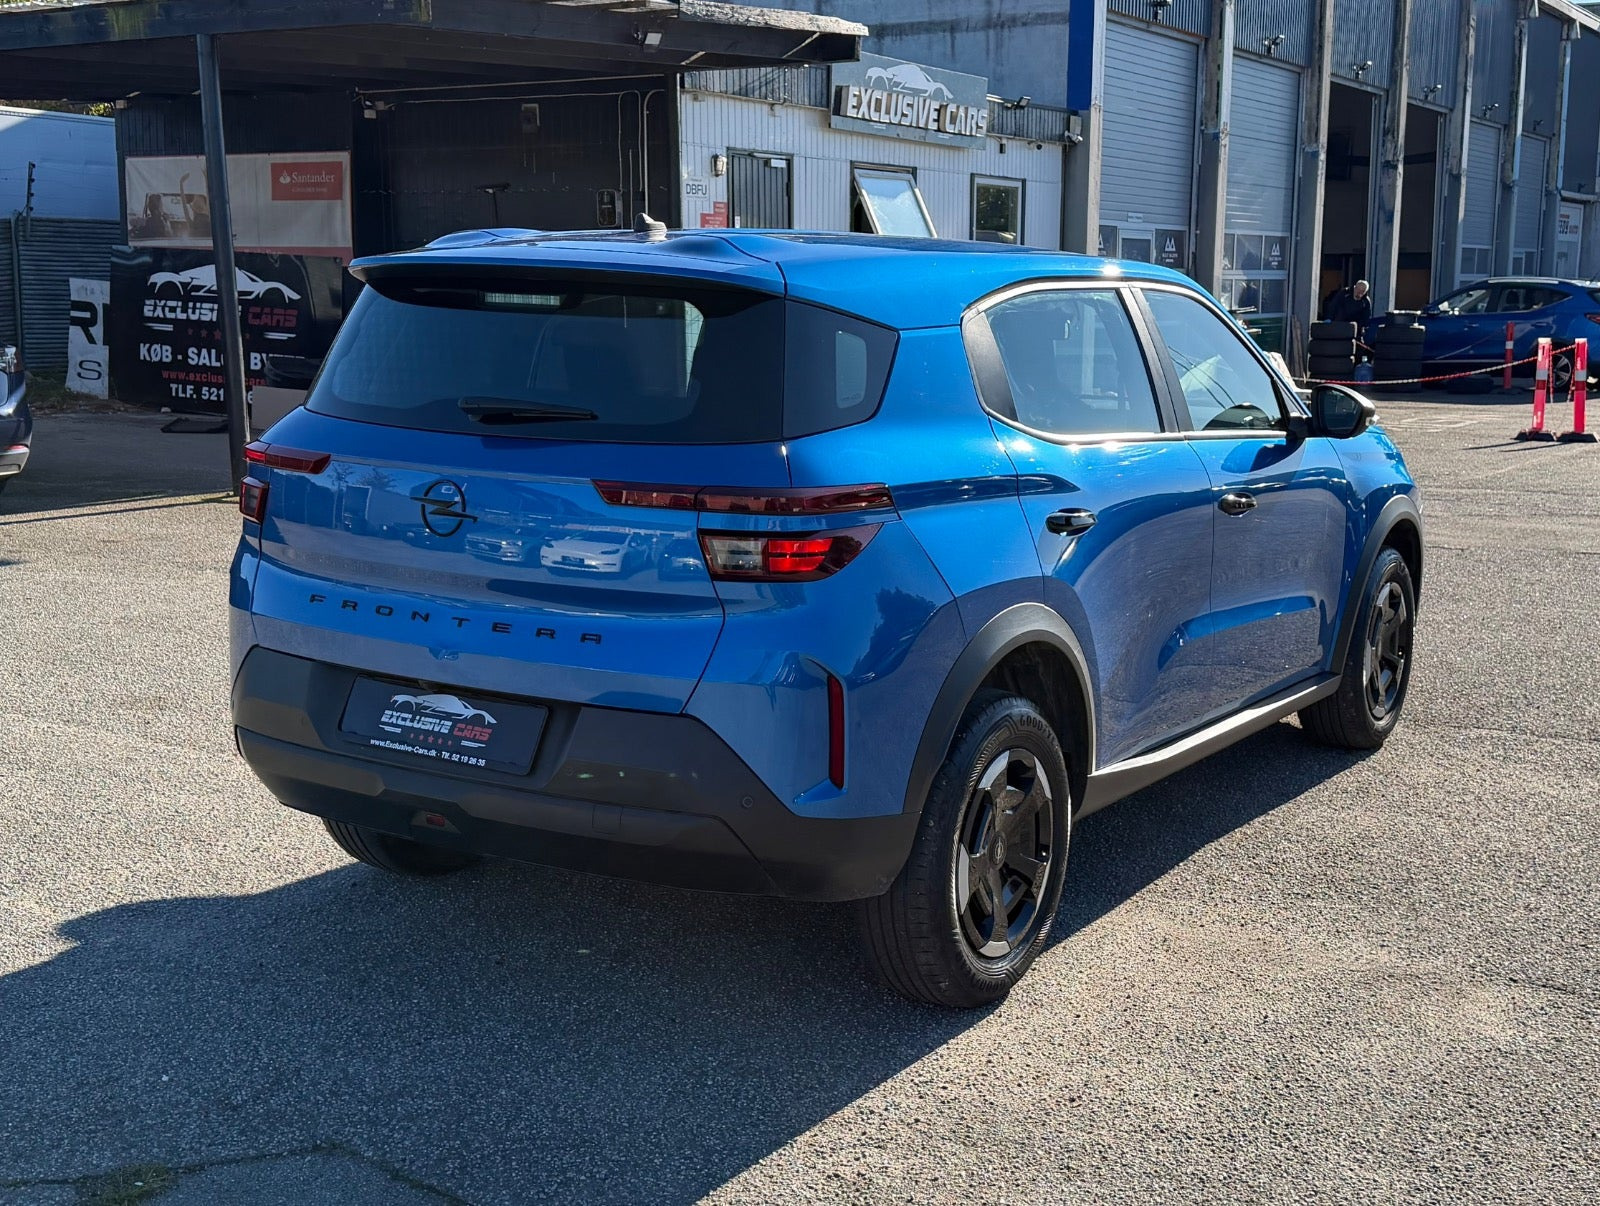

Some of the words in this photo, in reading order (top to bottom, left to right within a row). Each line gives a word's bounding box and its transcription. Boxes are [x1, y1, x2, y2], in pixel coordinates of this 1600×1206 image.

[846, 84, 940, 130] EXCLUSIVE
[945, 102, 987, 137] CARS
[291, 170, 336, 184] Santander
[685, 183, 707, 196] DBFU
[143, 299, 241, 322] EXCLUSI
[248, 306, 298, 328] CARS
[139, 343, 172, 363] KØB
[187, 347, 225, 367] SAL
[170, 384, 197, 399] TLF.
[309, 593, 602, 645] FRONTERA
[380, 709, 452, 734] EXCLUSIVE
[453, 723, 493, 741] CARS
[451, 753, 460, 762] 52
